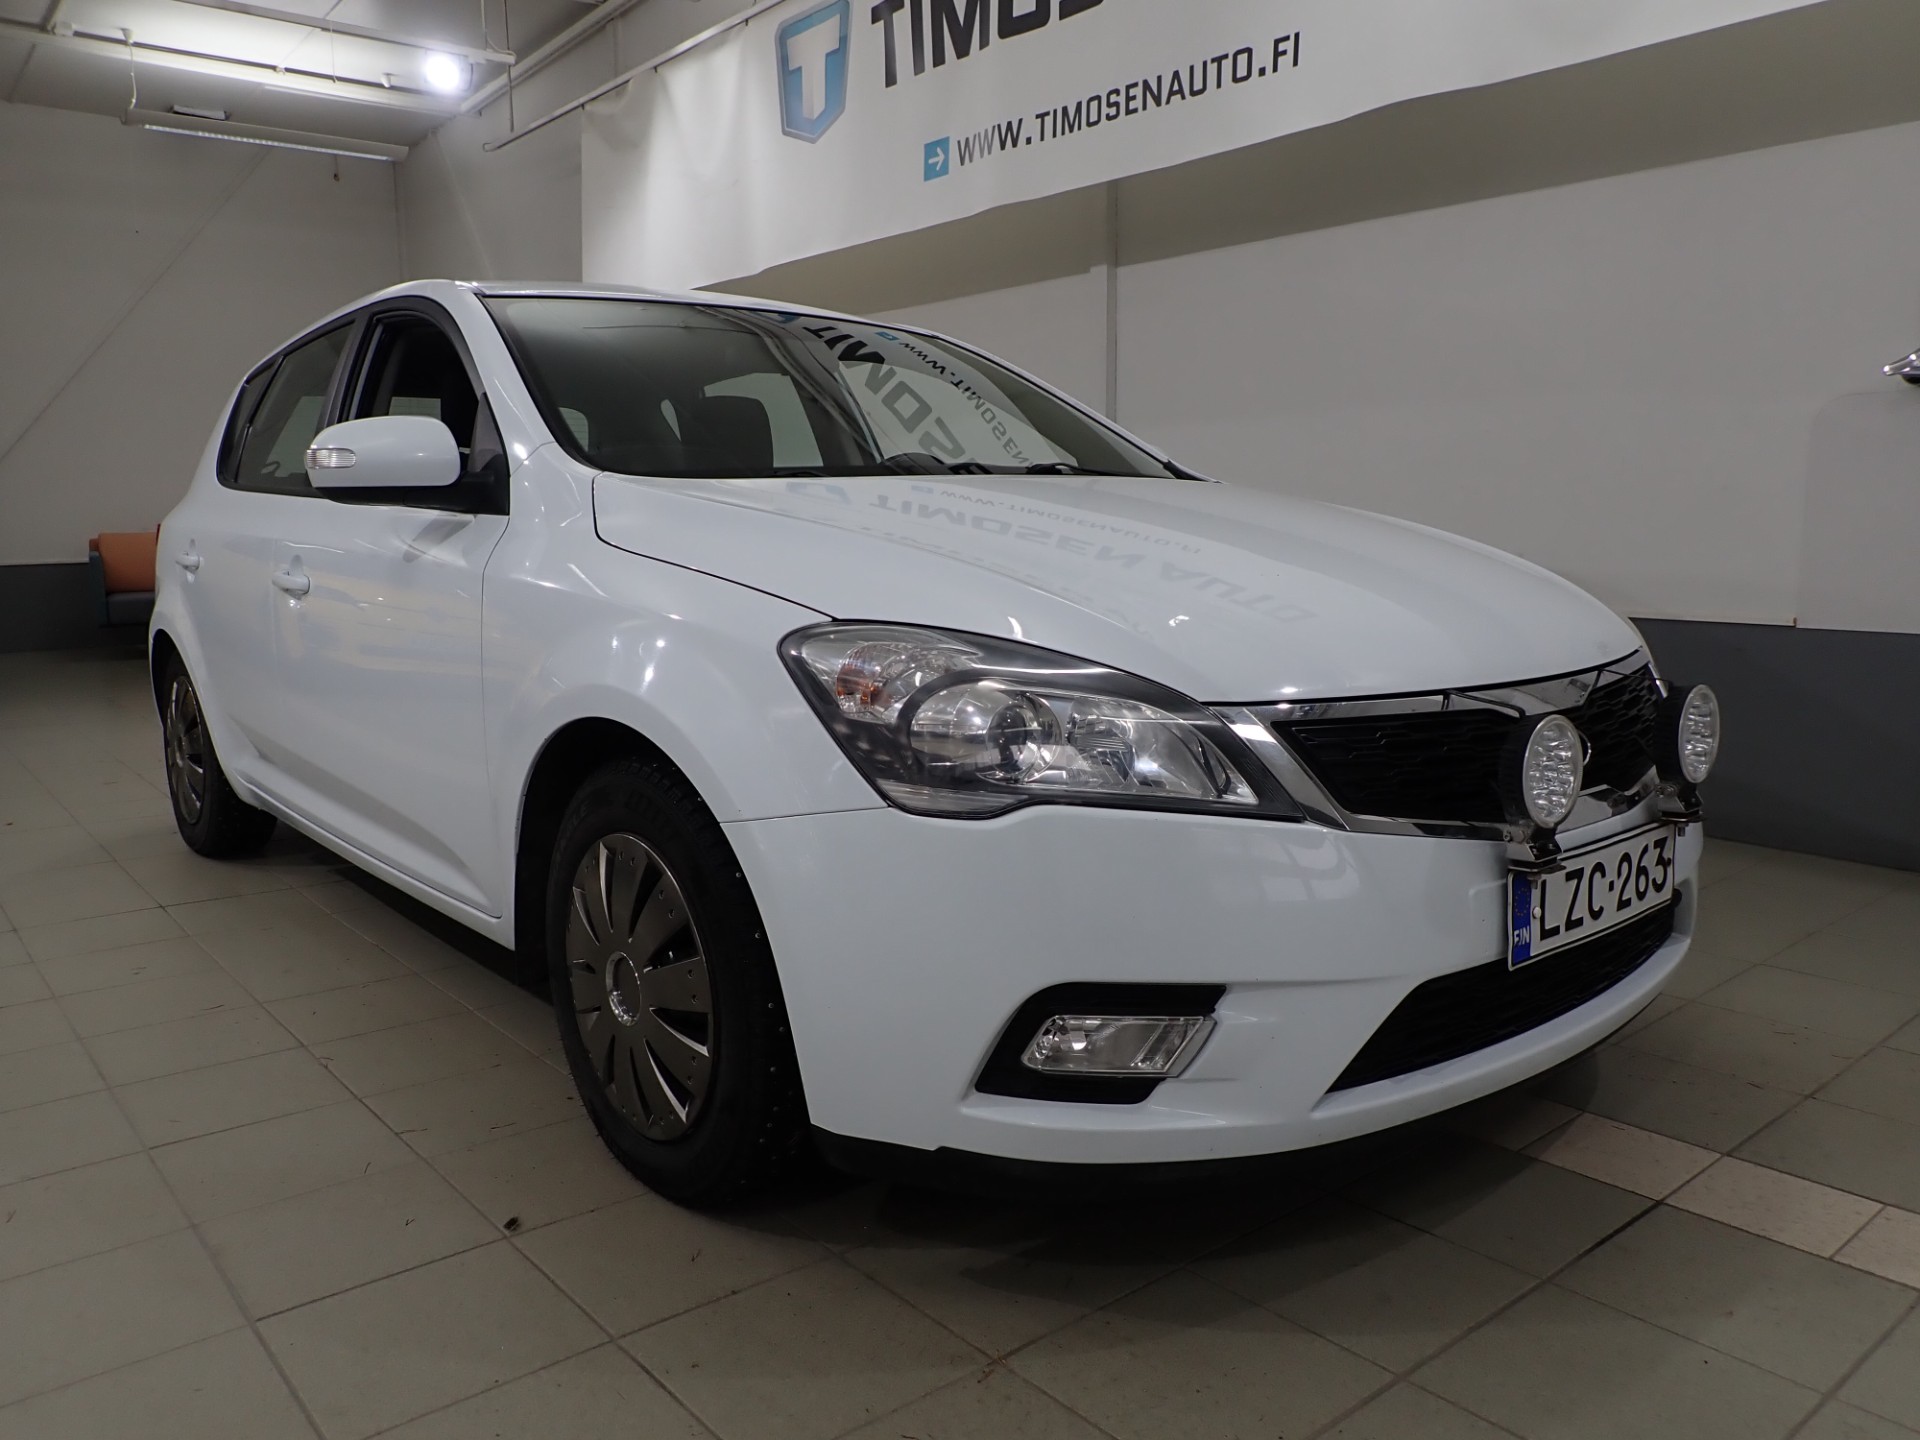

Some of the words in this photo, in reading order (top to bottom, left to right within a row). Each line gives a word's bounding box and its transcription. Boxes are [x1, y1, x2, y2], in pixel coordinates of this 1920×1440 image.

[871, 0, 1101, 88] TIM
[957, 32, 1300, 167] WWW.TIMOSENAUTO.FI
[1513, 925, 1530, 945] FIN
